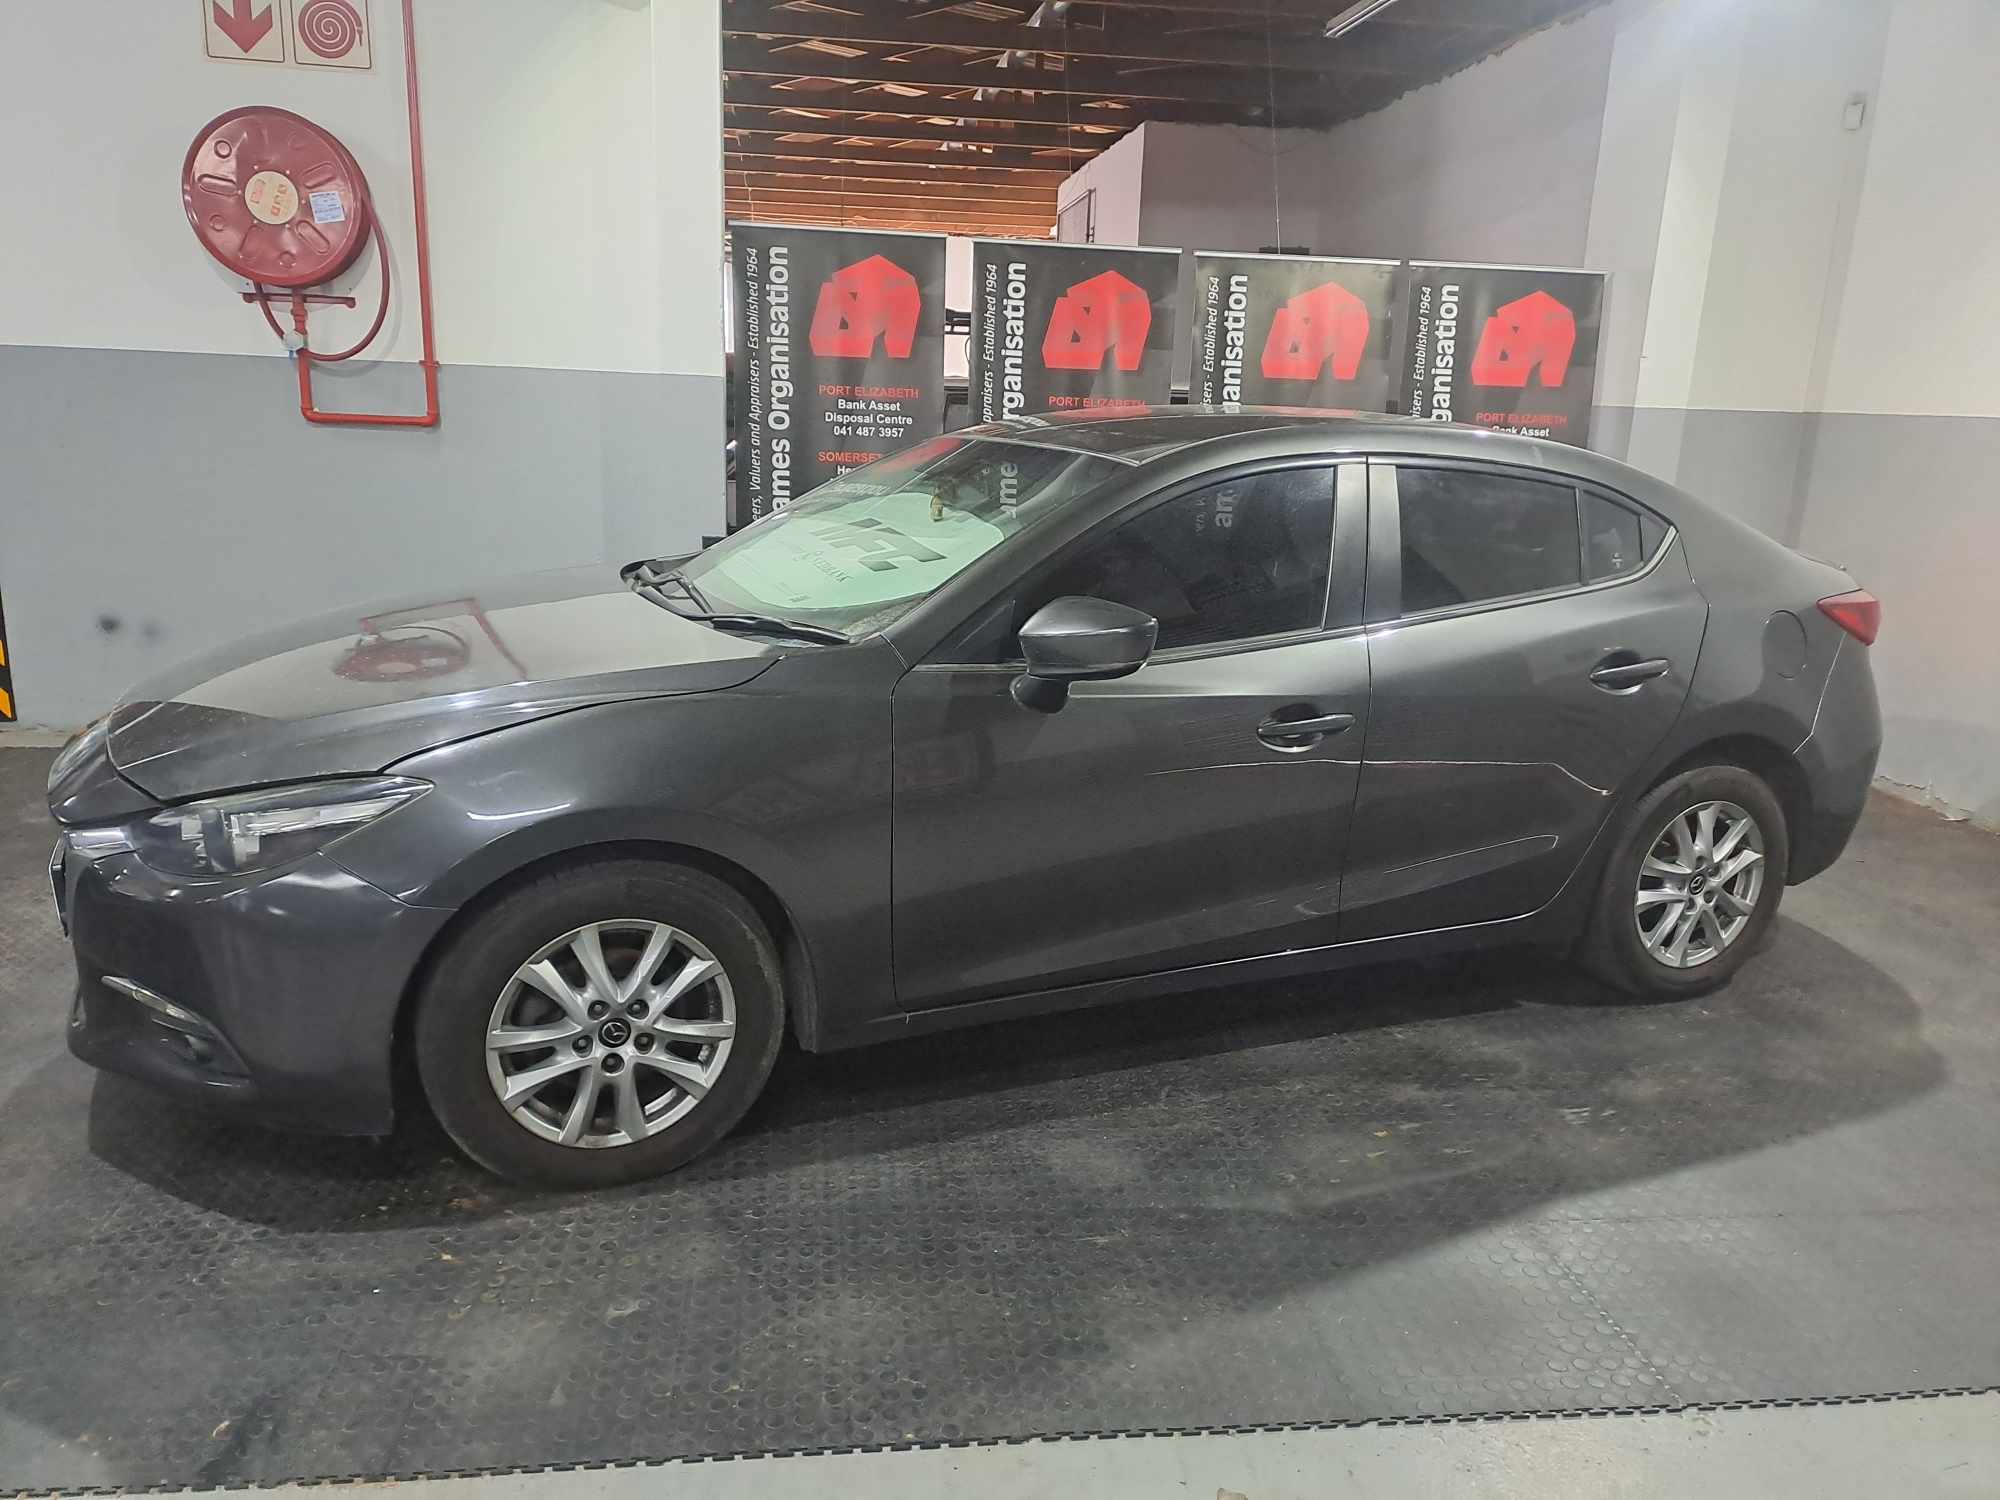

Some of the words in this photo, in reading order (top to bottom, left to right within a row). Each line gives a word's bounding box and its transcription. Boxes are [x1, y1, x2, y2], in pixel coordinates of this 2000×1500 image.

[746, 247, 758, 280] 1964
[985, 263, 998, 292] 1964
[1207, 276, 1220, 304] 1964
[1420, 286, 1432, 314] 1964
[746, 281, 759, 349] Established
[984, 295, 997, 361] Established
[766, 246, 794, 430] Organisation
[1002, 262, 1027, 419] rganisation
[1202, 307, 1218, 372] Established
[1413, 317, 1429, 380] Established
[747, 359, 763, 421] Appraisers
[818, 384, 851, 397] PORT
[855, 387, 920, 399] ELIZABETH
[1048, 395, 1080, 406] PORT
[825, 412, 874, 424] Disposal
[876, 414, 913, 425] Centre
[838, 399, 867, 411] Bank
[869, 400, 901, 412] Asset
[1476, 412, 1505, 422] PORT
[748, 422, 760, 446] and
[833, 426, 852, 436] 041
[856, 427, 875, 437] 487
[878, 428, 904, 438] 3957
[1520, 427, 1550, 437] Asset
[748, 449, 760, 490] Valuers
